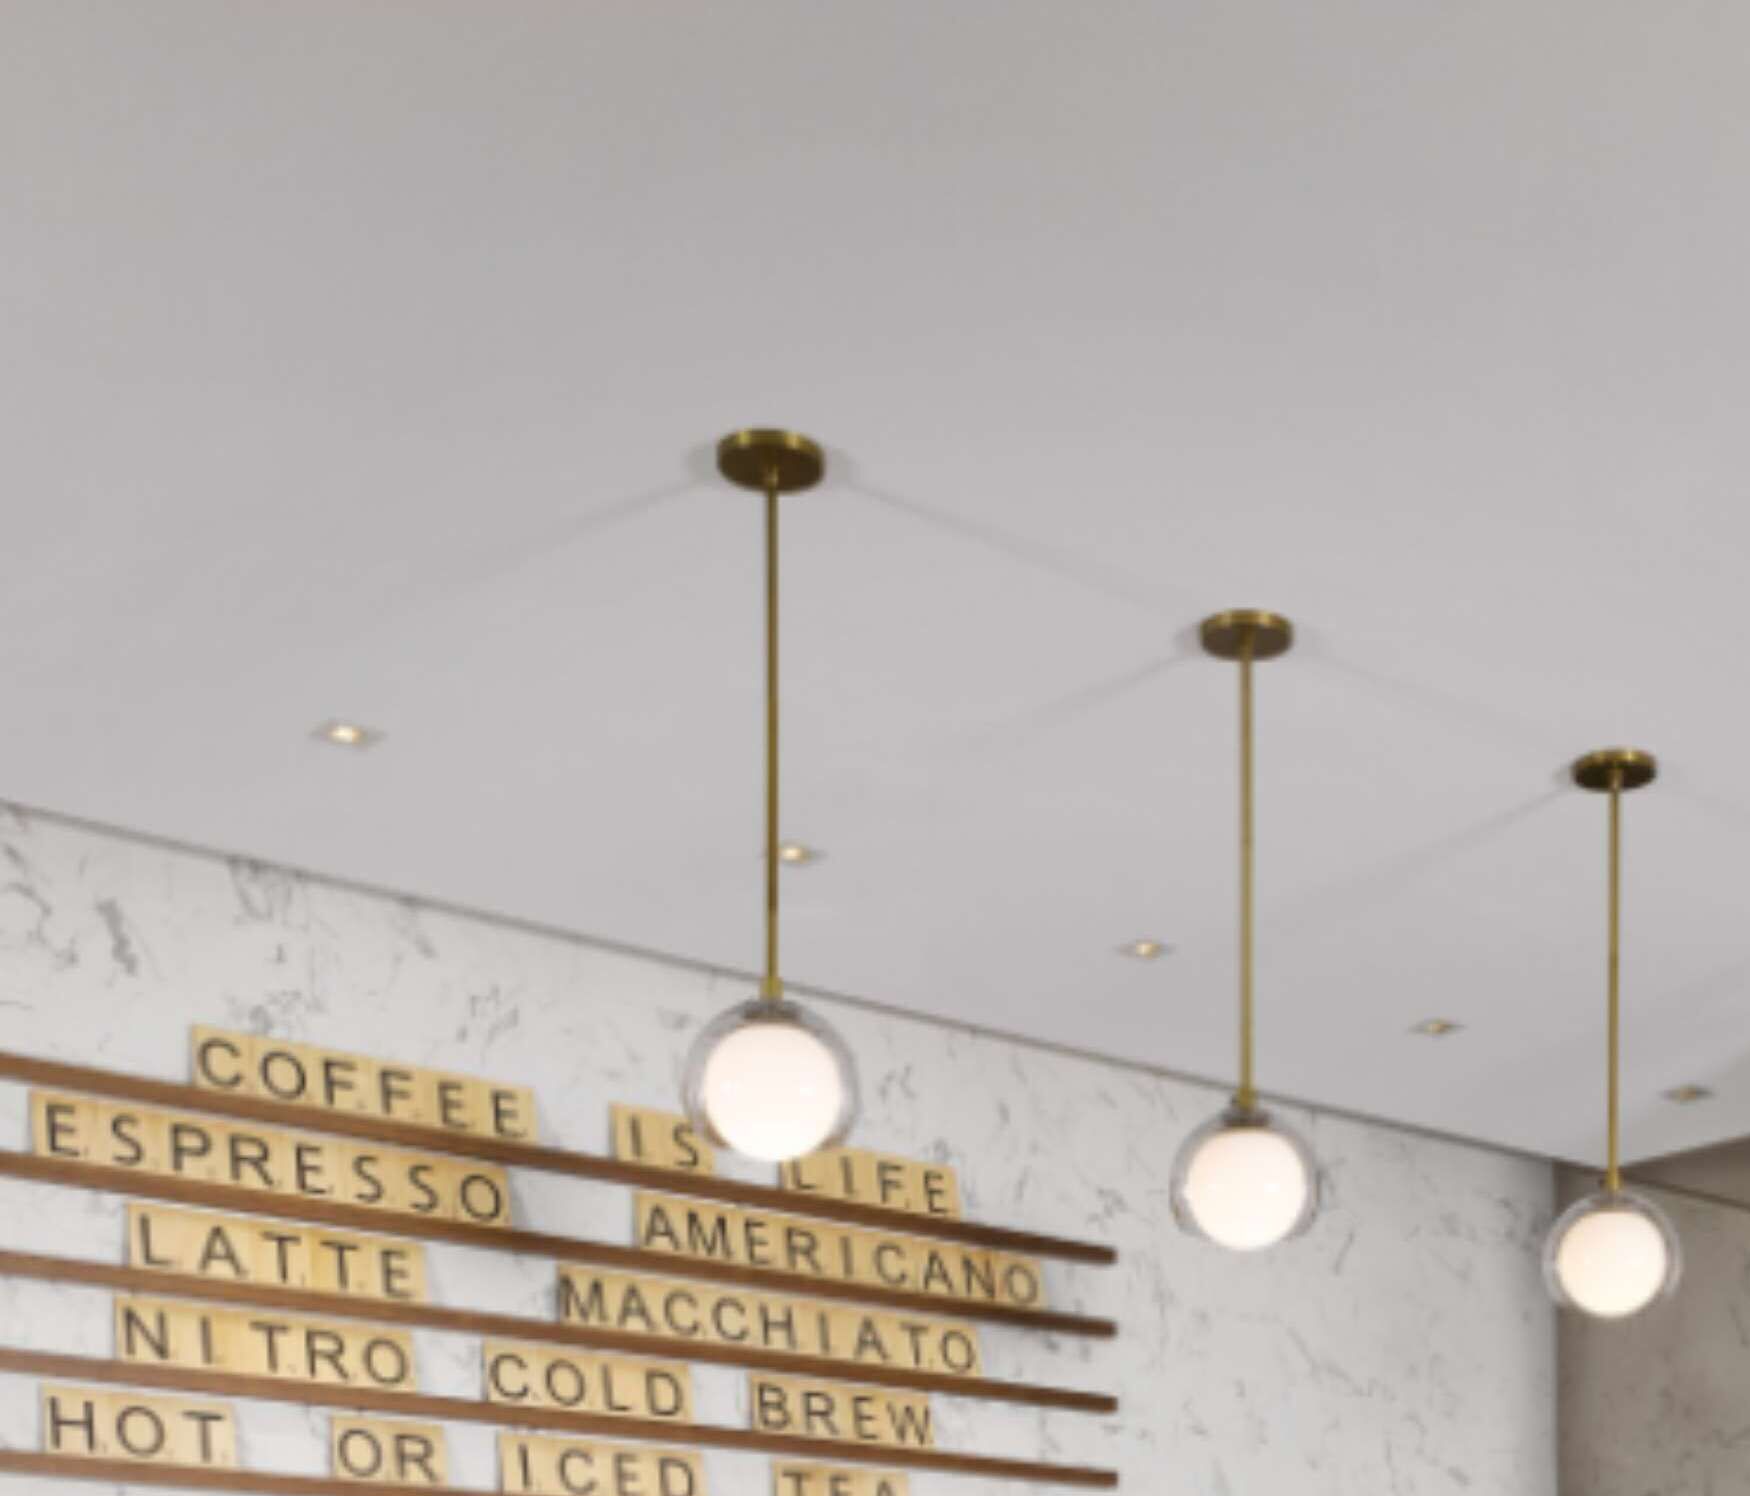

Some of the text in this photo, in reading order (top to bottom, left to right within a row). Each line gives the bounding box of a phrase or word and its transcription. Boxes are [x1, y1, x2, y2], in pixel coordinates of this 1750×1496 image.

[44, 1103, 1039, 1306] ESPRESSO AMERICANO
[198, 1037, 949, 1214] COFFEE IS LIFE
[139, 1212, 977, 1374] LATTE MACCHIATO
[48, 1395, 225, 1463] HOT
[337, 1428, 438, 1483] OR
[122, 1307, 931, 1443] NITRO COLD BREW
